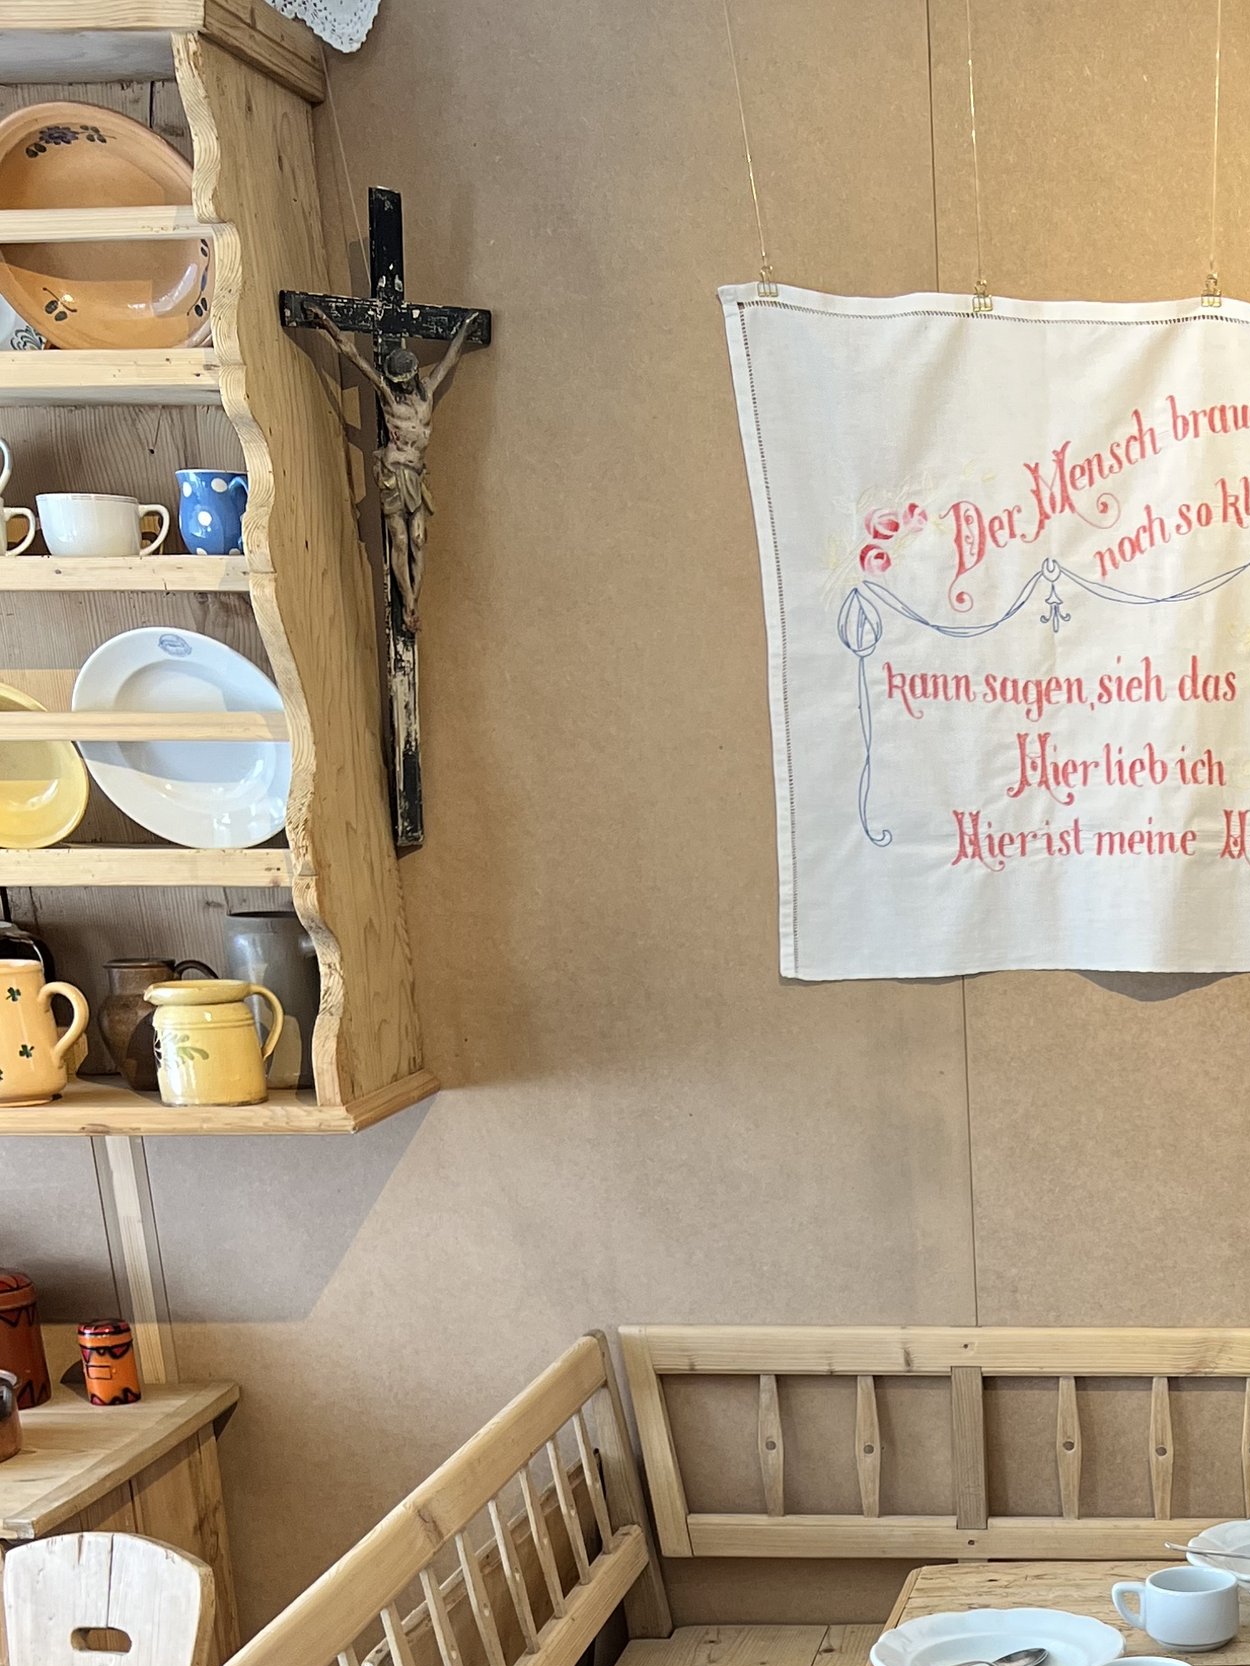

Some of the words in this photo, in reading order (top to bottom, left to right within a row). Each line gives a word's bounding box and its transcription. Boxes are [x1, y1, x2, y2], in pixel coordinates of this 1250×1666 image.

[938, 500, 1023, 613] Der
[1019, 407, 1162, 543] Mensch
[1094, 504, 1170, 578] noch
[1176, 501, 1214, 534] so
[883, 662, 976, 719] kann
[983, 671, 1095, 722] sagen,
[1097, 655, 1167, 704] sieh
[1178, 655, 1237, 703] das
[1006, 732, 1100, 806] Hier
[1102, 742, 1169, 787] lieb
[1175, 744, 1227, 786] ich
[950, 809, 1038, 872] Hier
[1039, 817, 1085, 856] ist
[1092, 816, 1197, 857] meine
